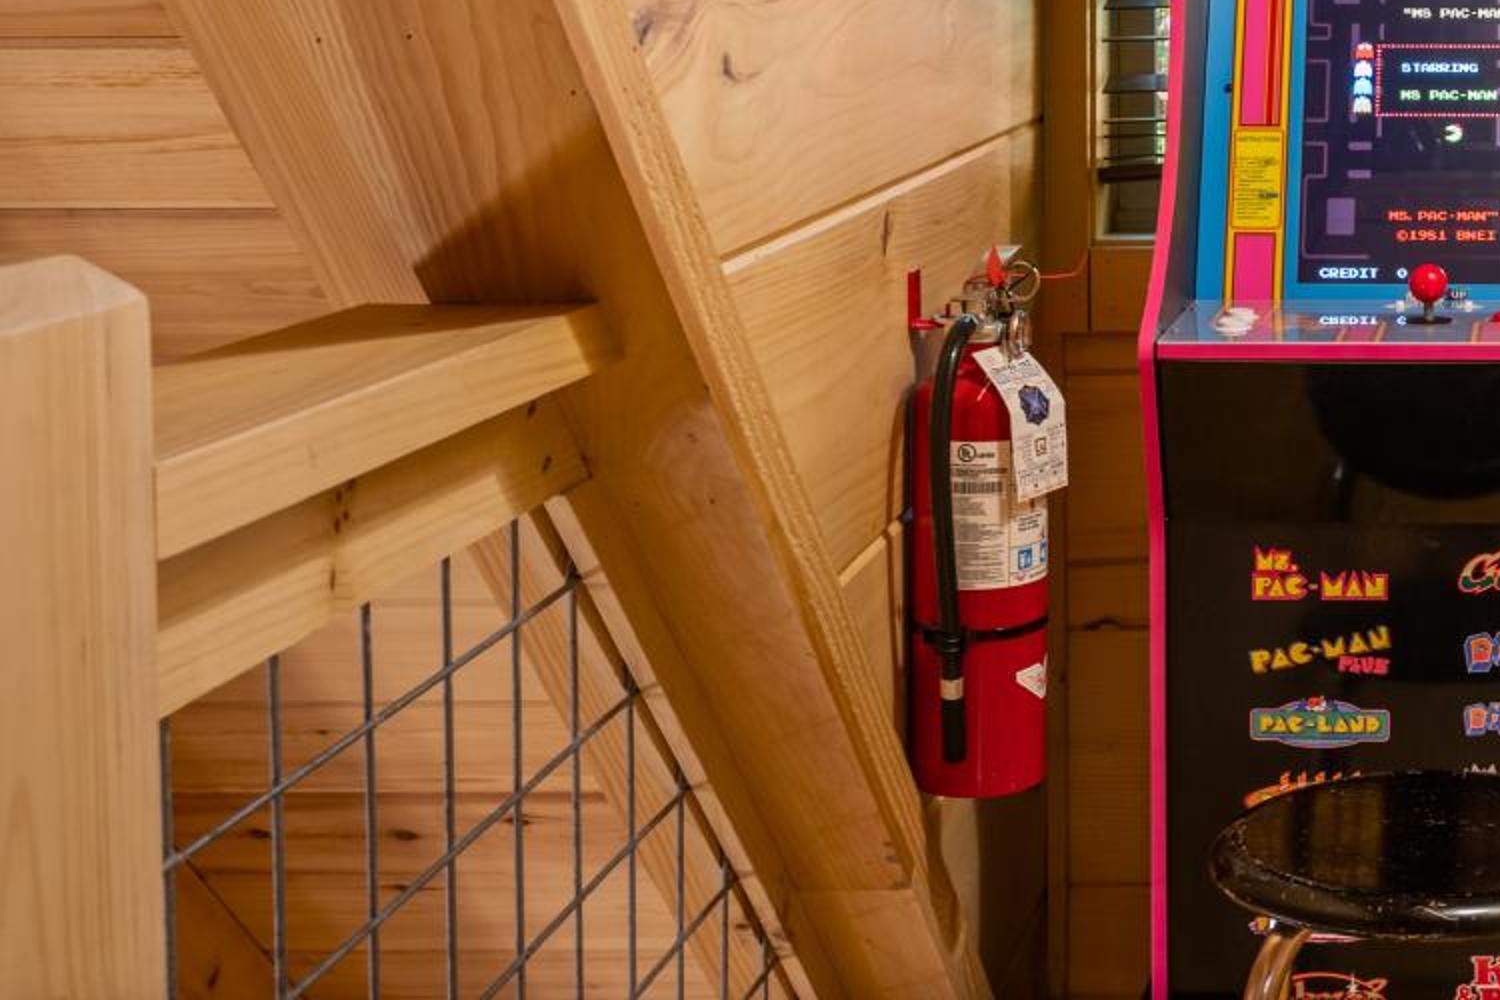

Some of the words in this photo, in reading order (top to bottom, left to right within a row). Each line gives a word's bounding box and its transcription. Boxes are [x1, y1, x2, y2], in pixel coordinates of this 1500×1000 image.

[1401, 62, 1479, 74] STARRING
[1400, 89, 1420, 101] MS
[1429, 89, 1499, 101] PAC-MAN
[1319, 267, 1379, 280] CREDIT
[1252, 570, 1390, 600] PAC-MAN
[1250, 624, 1393, 675] PAC-MAN
[1258, 712, 1381, 734] PAC-LAND
